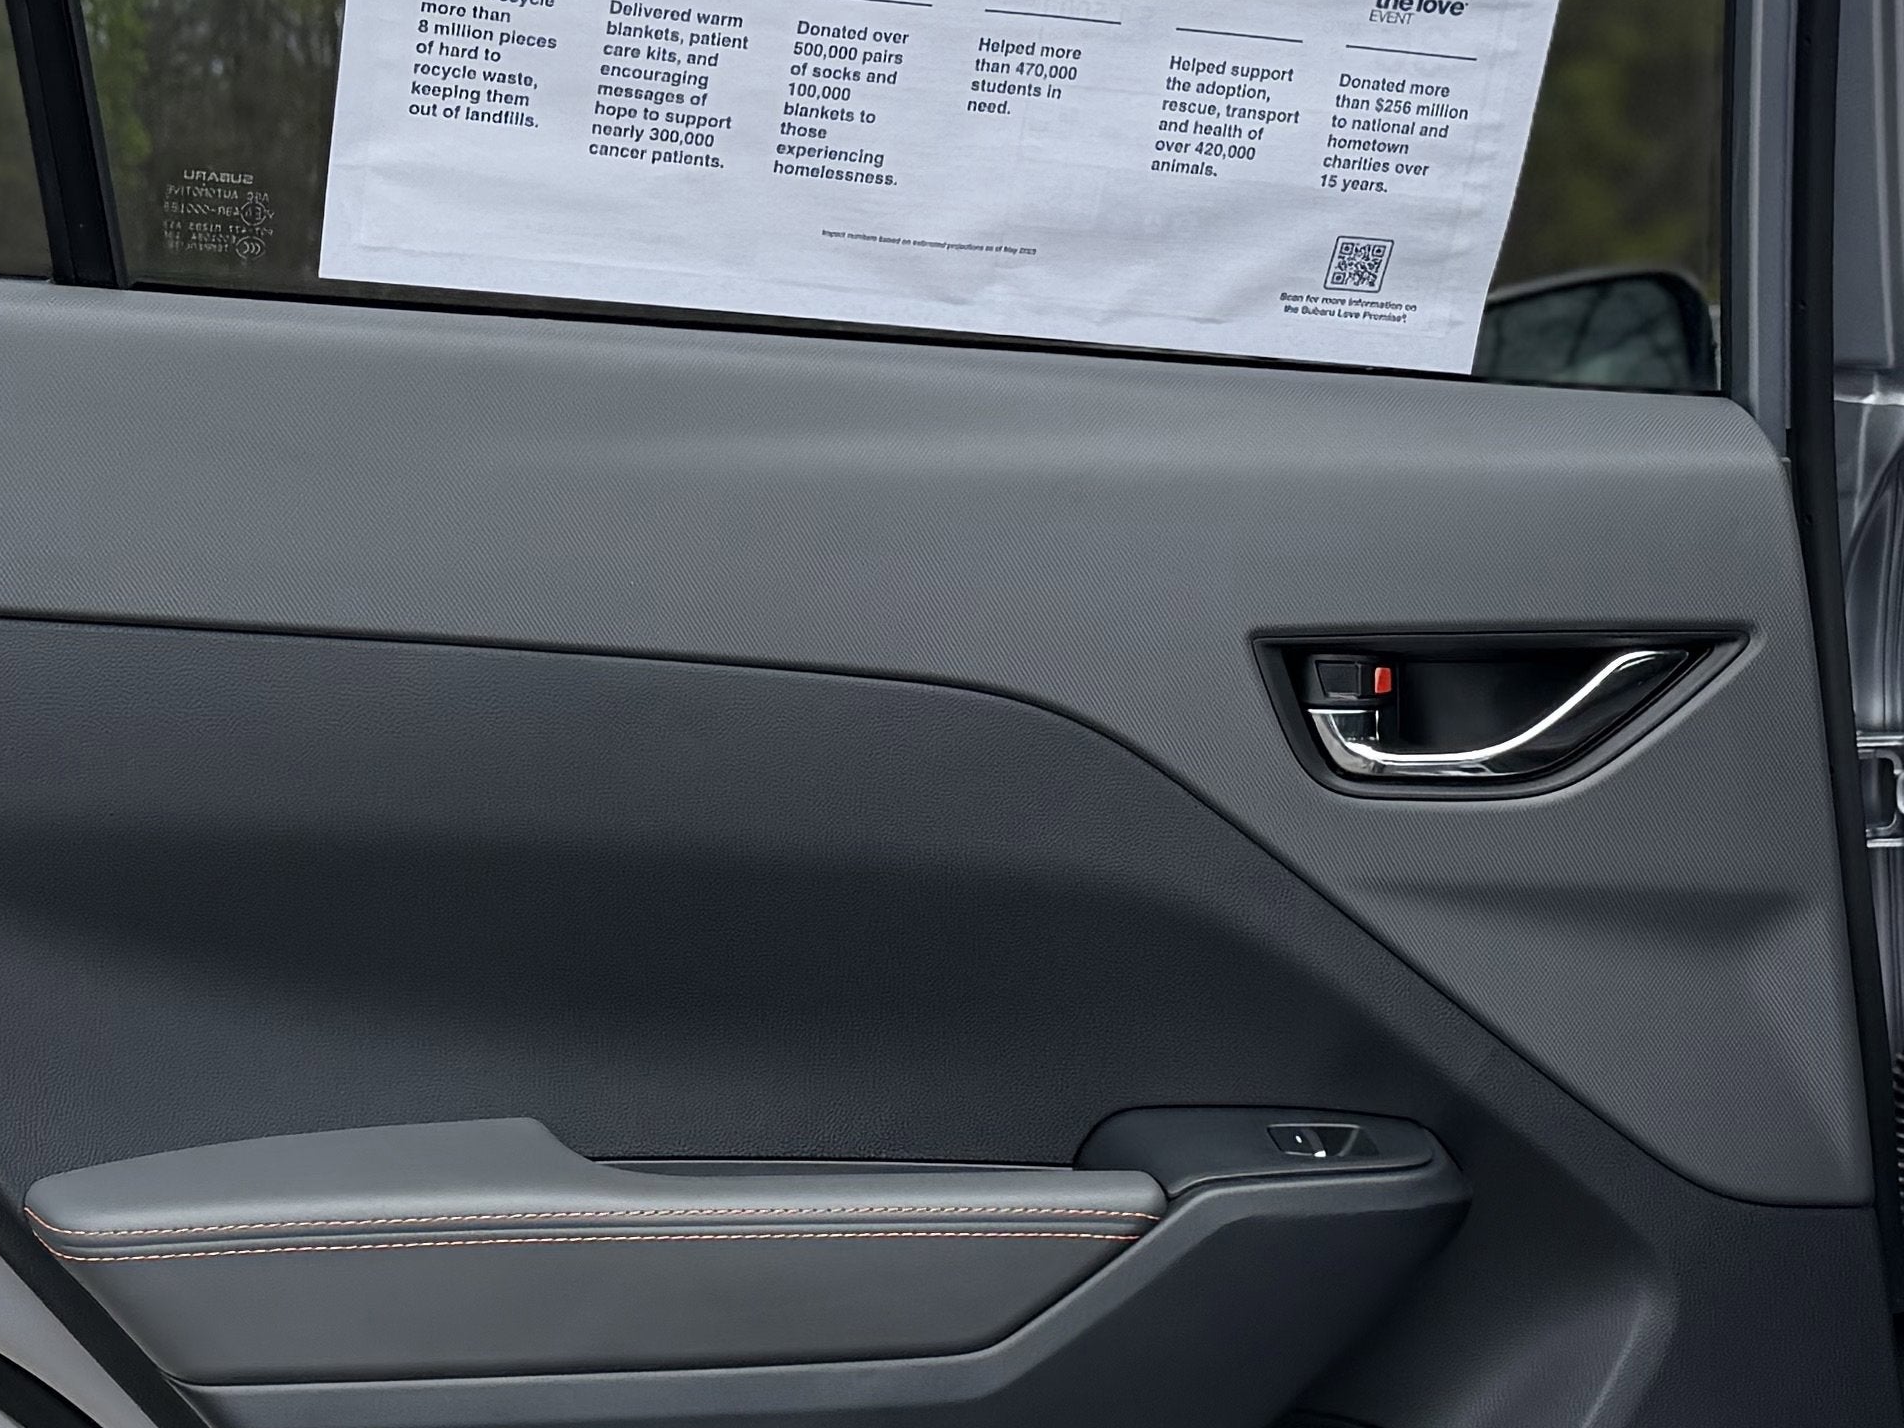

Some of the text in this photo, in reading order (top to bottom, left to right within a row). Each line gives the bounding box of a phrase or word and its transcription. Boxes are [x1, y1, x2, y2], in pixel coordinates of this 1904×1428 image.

[421, 2, 510, 23] more than
[609, 0, 743, 27] Delivered warm
[1368, 9, 1416, 25] EVENT
[418, 19, 557, 48] 8 million pieces
[606, 21, 748, 49] blankets, patient
[797, 21, 909, 44] Donated over
[416, 41, 501, 62] of hard to
[603, 44, 719, 67] care kits, and
[794, 42, 903, 64] 500,000 pairs
[978, 37, 1081, 59] Helped more
[414, 63, 537, 89] recycle waste,
[600, 64, 709, 89] encouraging
[790, 63, 897, 84] of socks and
[975, 58, 1077, 80] than 470,000
[1169, 55, 1294, 83] Helped support
[411, 81, 529, 106] keeping them
[597, 84, 708, 106] messages of
[789, 82, 851, 101] 100,000
[971, 79, 1062, 99] students in
[1166, 76, 1271, 104] the adoption,
[1338, 73, 1450, 98] Donated more
[409, 104, 538, 128] out of landfills.
[595, 101, 732, 129] hope to support
[783, 102, 876, 123] blankets to
[967, 100, 1010, 114] need.
[1162, 99, 1300, 125] rescue, transport
[1335, 94, 1469, 120] than $256 million
[592, 124, 714, 147] nearly 300,000
[780, 122, 827, 139] those
[1158, 118, 1264, 141] and health of
[1331, 114, 1450, 139] to national and
[589, 143, 724, 168] cancer patients.
[776, 143, 884, 168] experiencing
[1154, 140, 1256, 161] over 420,000
[1327, 133, 1409, 155] hometown
[774, 160, 897, 185] homelessness.
[1150, 158, 1218, 177] animals.
[1322, 154, 1430, 176] charities over
[1320, 174, 1388, 193] 15 years.
[1280, 292, 1417, 312] Scan for more information on
[1284, 304, 1299, 314] the
[1301, 305, 1335, 317] Subaru
[1337, 308, 1360, 319] Love
